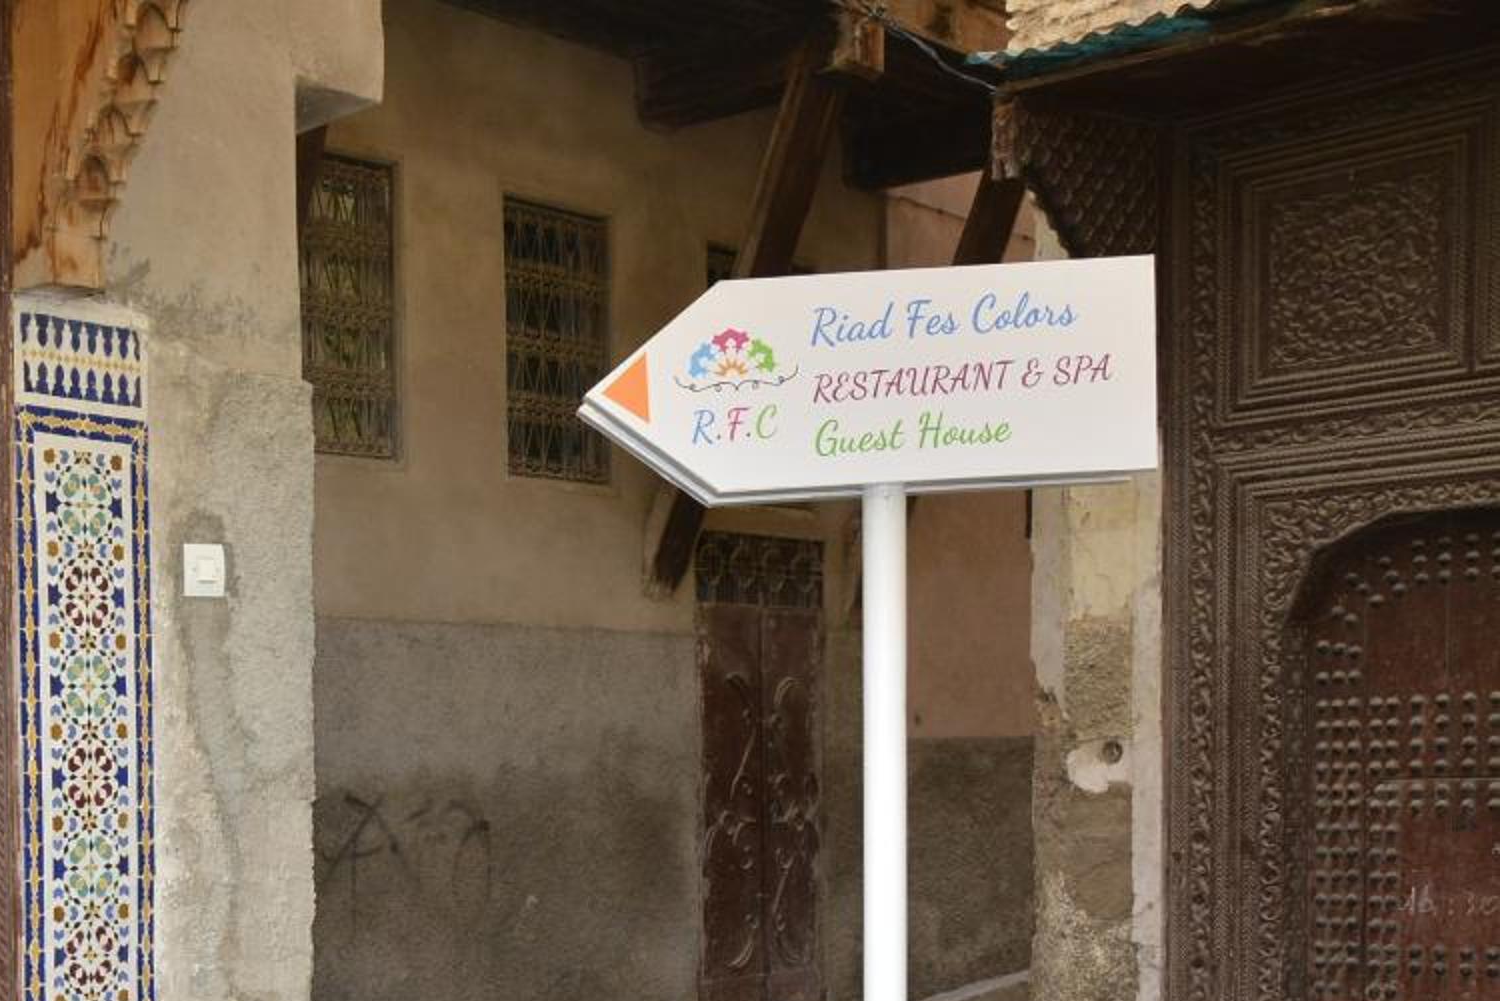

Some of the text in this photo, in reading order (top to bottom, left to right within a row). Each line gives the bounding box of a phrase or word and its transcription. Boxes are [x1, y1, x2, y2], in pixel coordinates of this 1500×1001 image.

[811, 291, 1077, 347] Riad Fes Colors
[813, 354, 1114, 403] RESTAURANT & SPA
[692, 404, 778, 444] R.F.C
[815, 411, 1012, 456] Guest House
